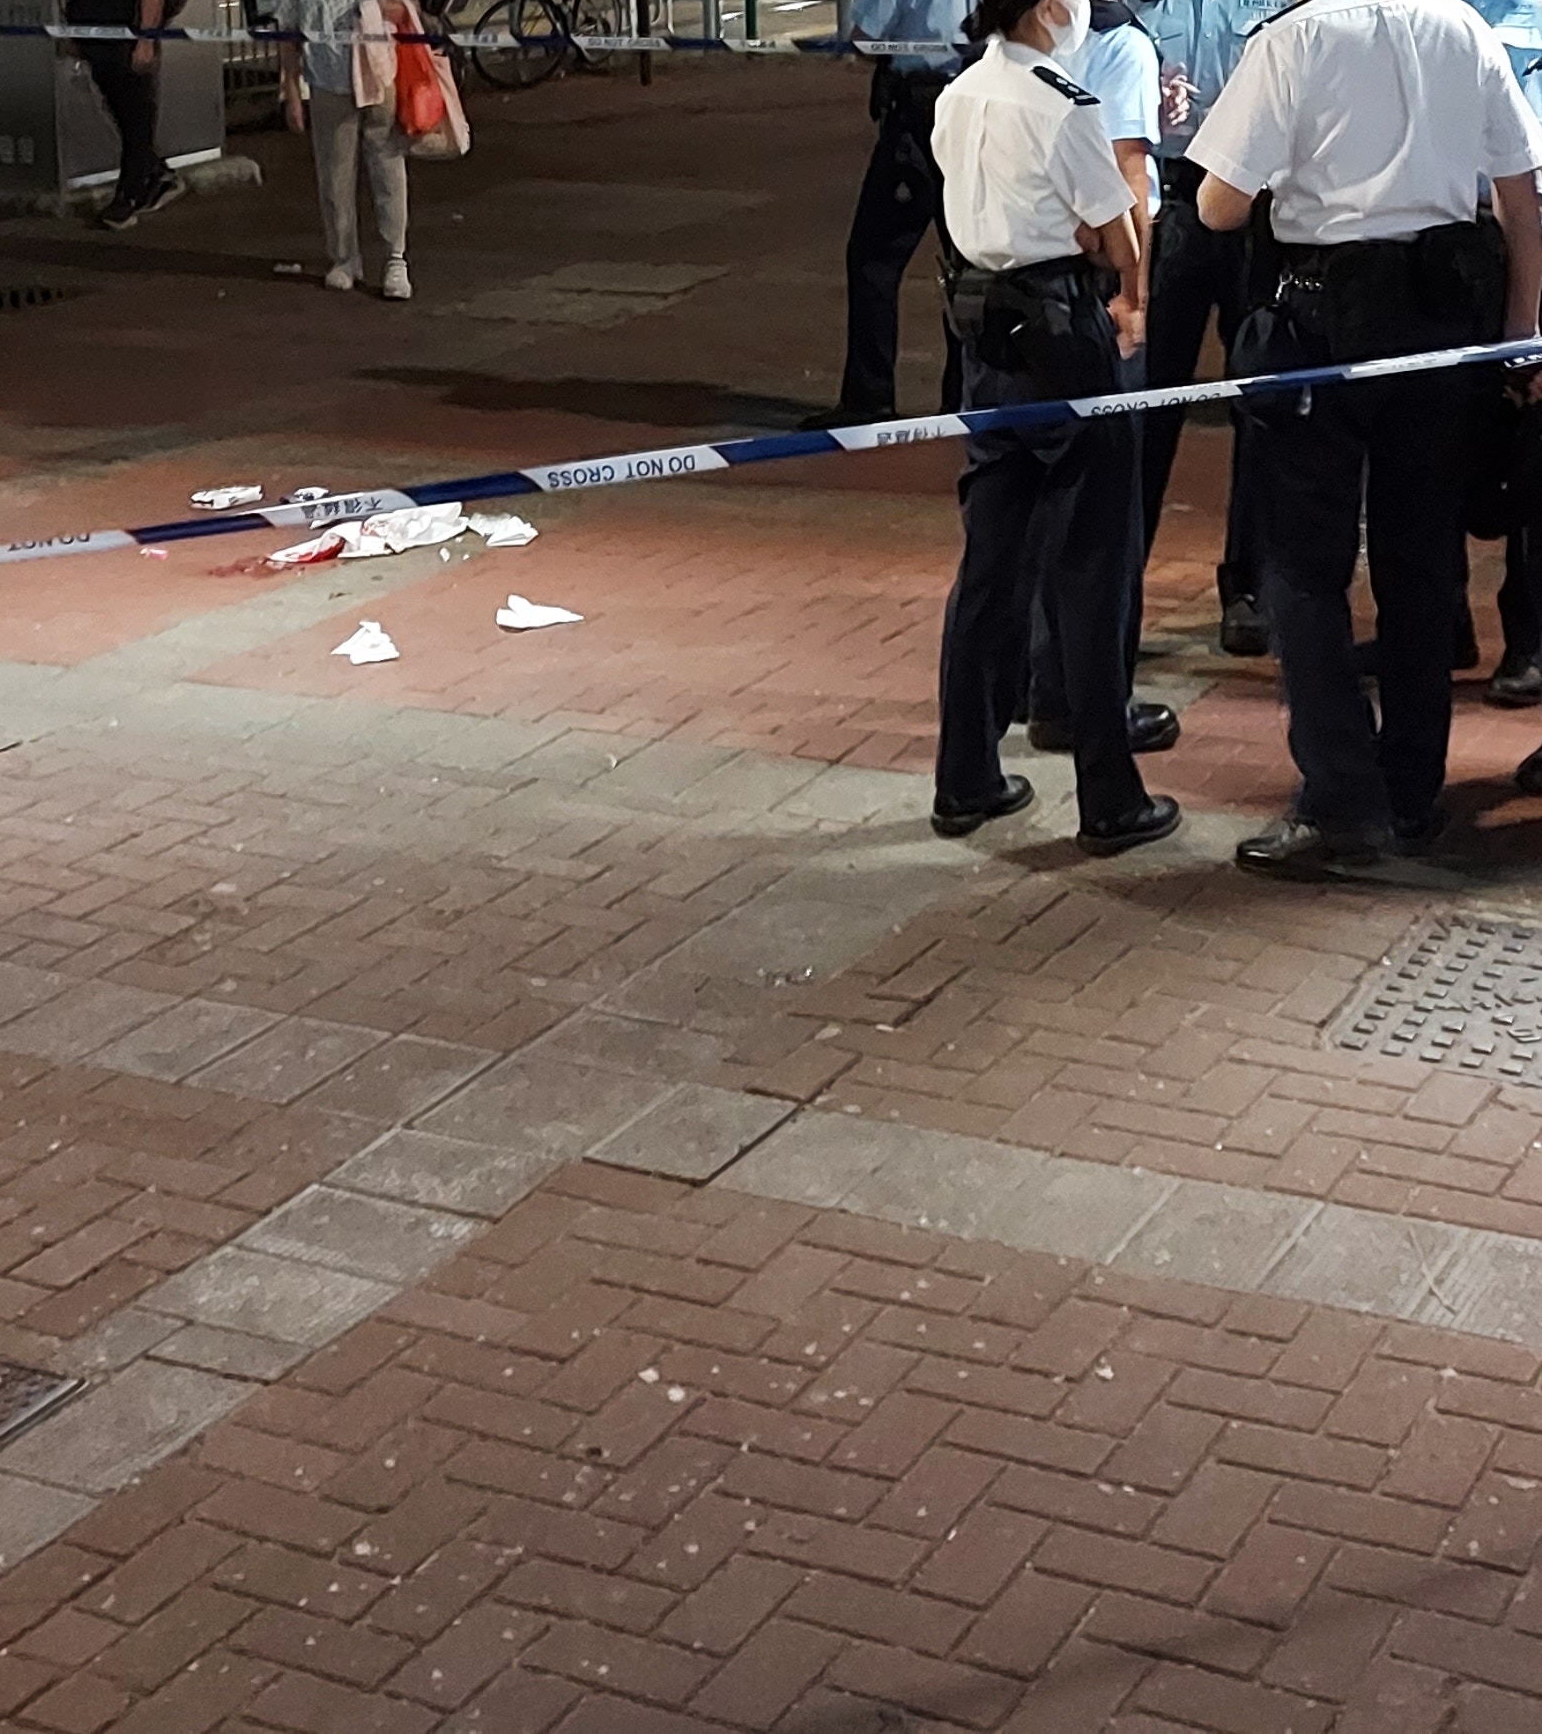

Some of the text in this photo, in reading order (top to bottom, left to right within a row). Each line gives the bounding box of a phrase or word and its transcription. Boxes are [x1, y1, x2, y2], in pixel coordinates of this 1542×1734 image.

[547, 454, 696, 488] DO NOT CROSS
